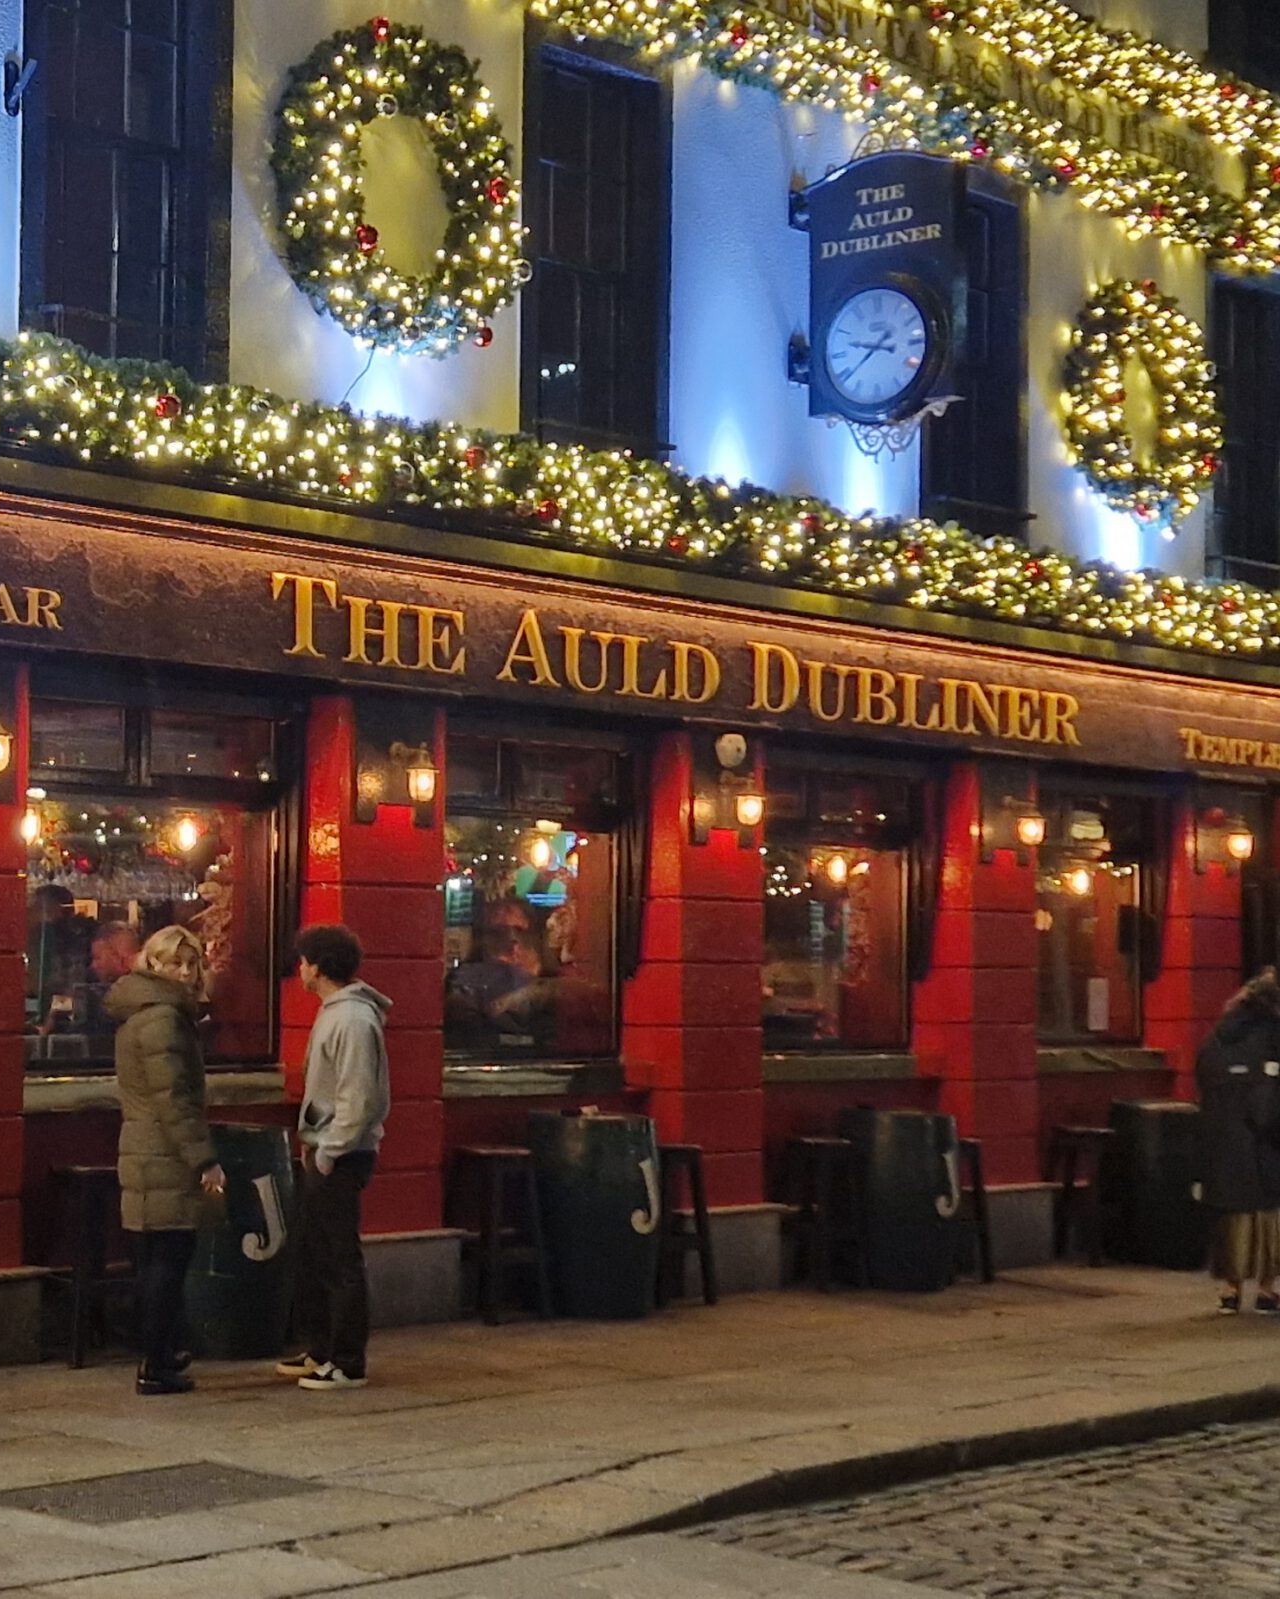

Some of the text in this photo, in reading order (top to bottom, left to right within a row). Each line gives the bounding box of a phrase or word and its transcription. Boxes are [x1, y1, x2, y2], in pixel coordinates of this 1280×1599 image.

[856, 184, 905, 206] THE
[848, 206, 913, 231] AULD
[821, 224, 942, 259] DUBLINER
[271, 572, 1081, 746] THE AULD DUBLINER
[241, 1173, 287, 1261] J
